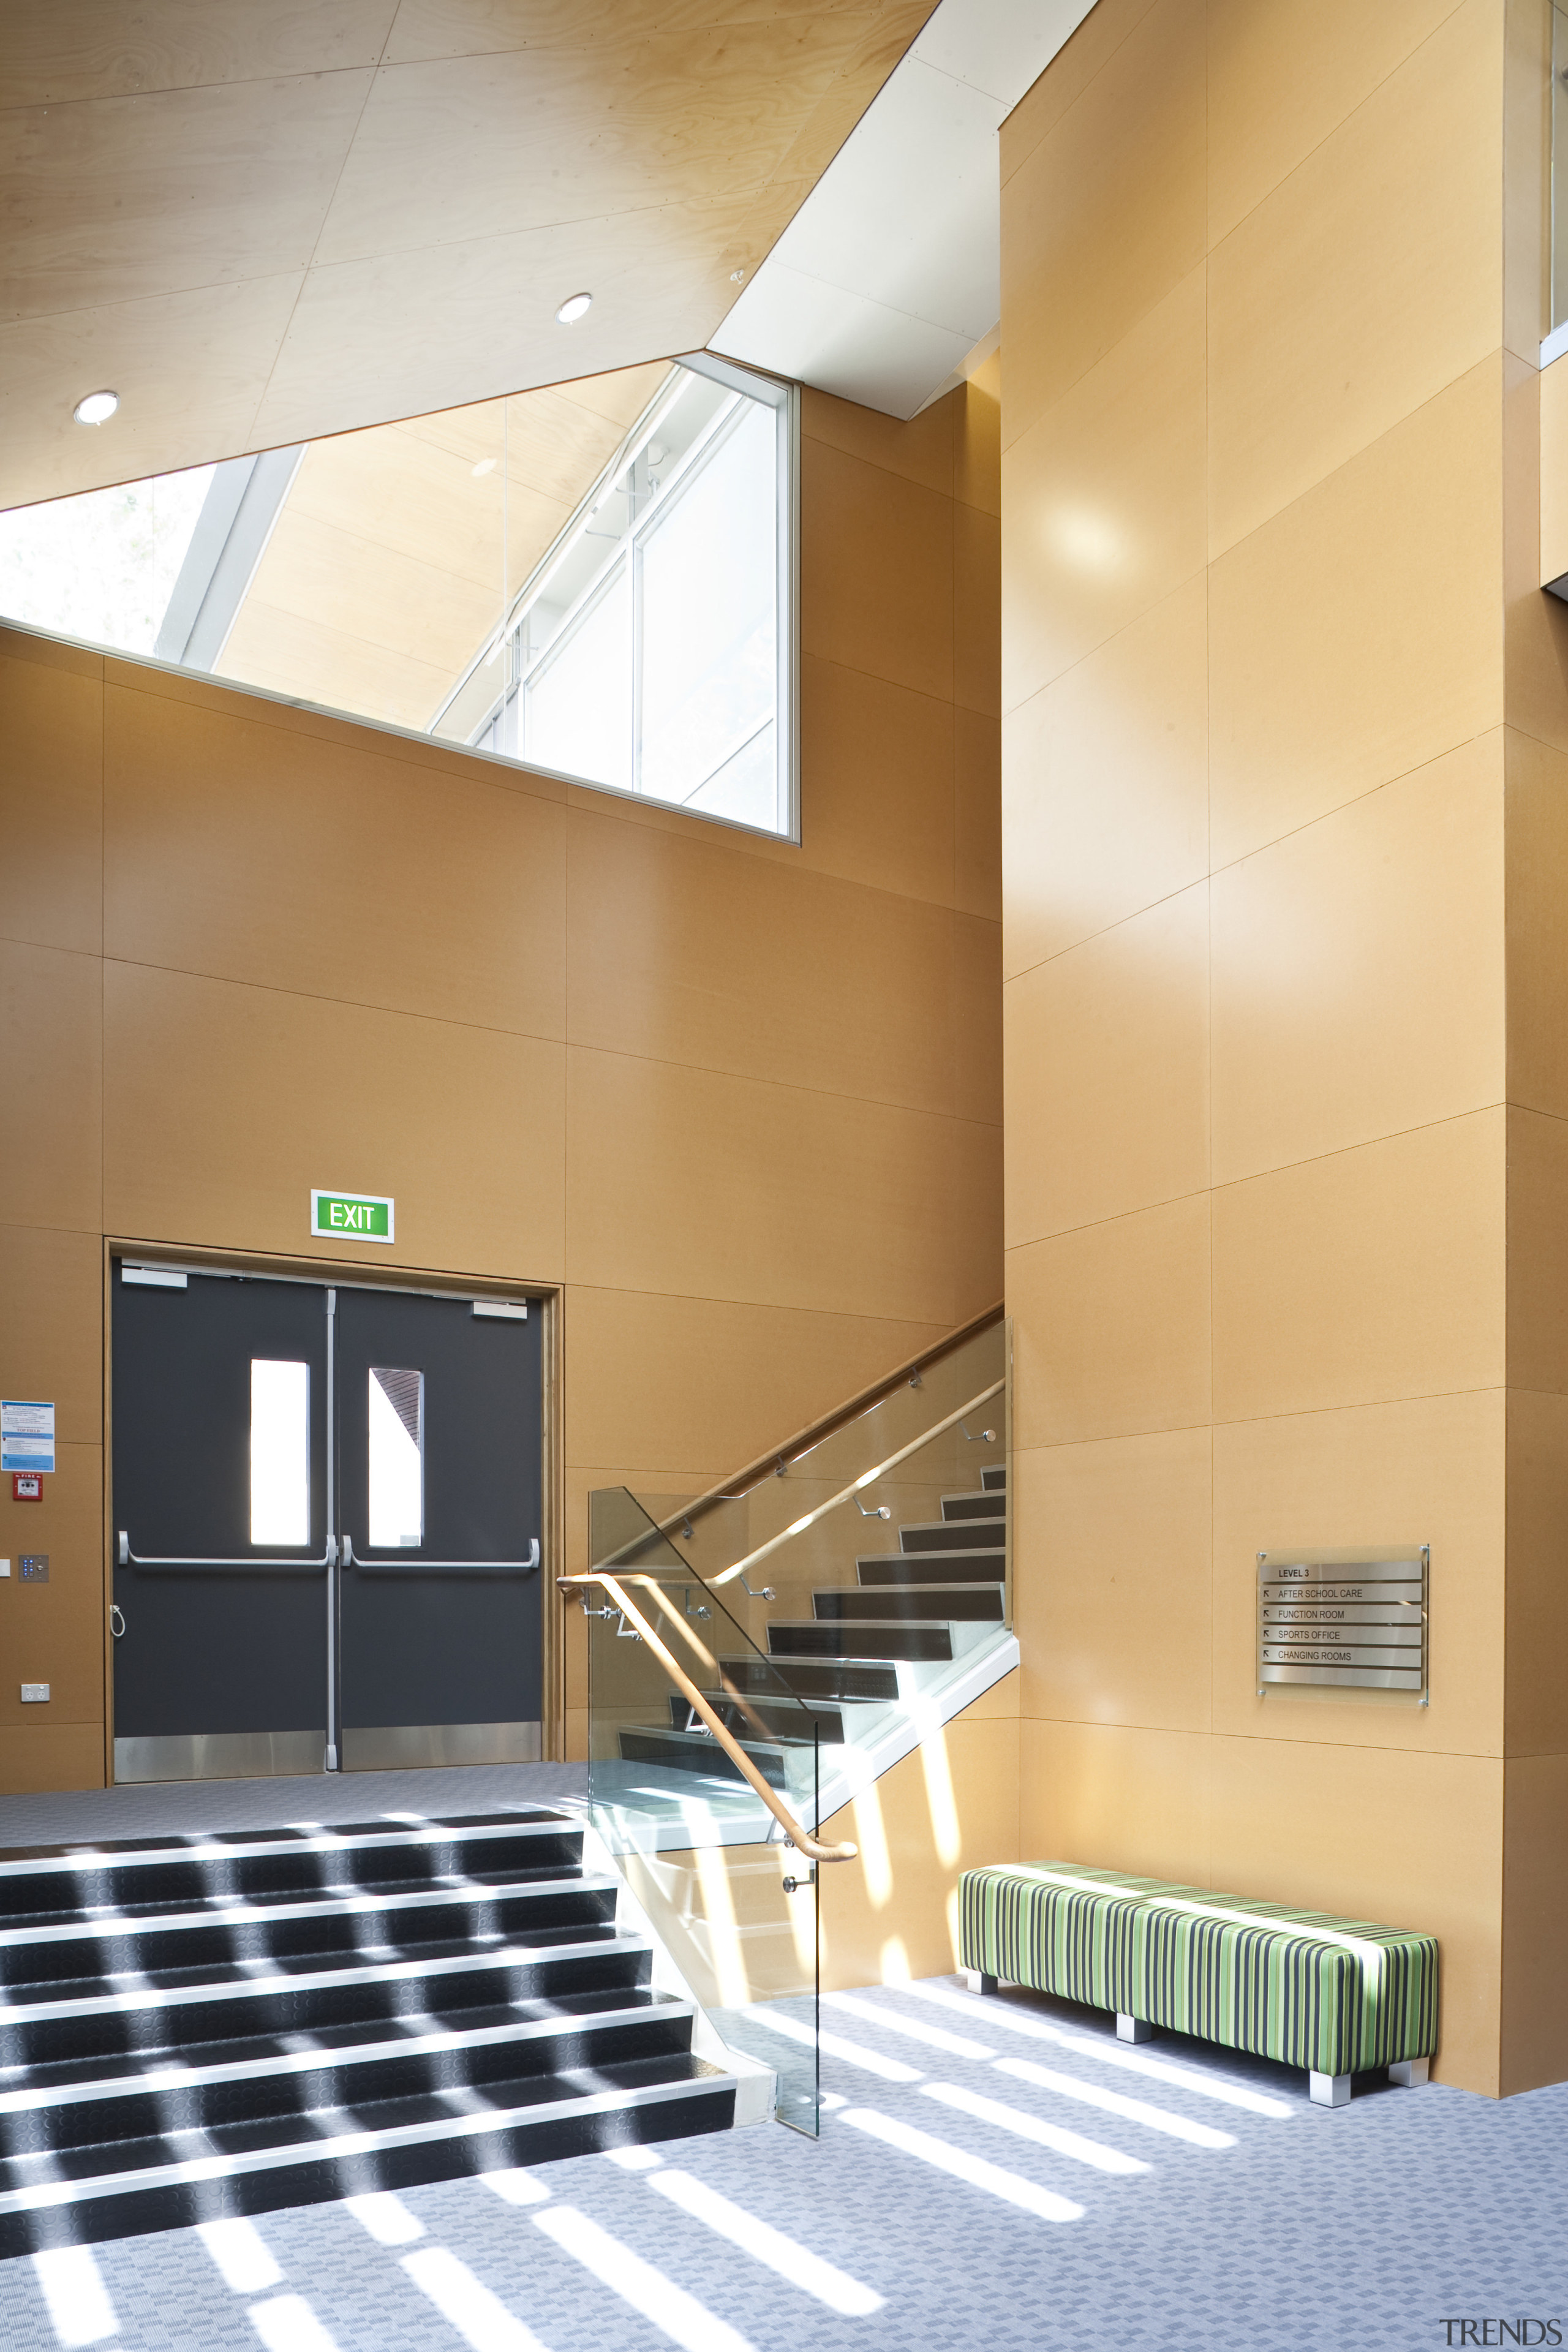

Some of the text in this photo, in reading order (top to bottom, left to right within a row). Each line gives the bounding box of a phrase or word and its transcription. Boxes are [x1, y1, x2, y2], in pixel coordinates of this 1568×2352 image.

[330, 1202, 375, 1230] EXIT
[1305, 1589, 1338, 1598] SCHOOL
[1278, 1610, 1344, 1619] FUNCTION ROOM
[1278, 1630, 1340, 1640] SPORTS OFFICE
[1278, 1651, 1352, 1660] CHANGING ROOMS
